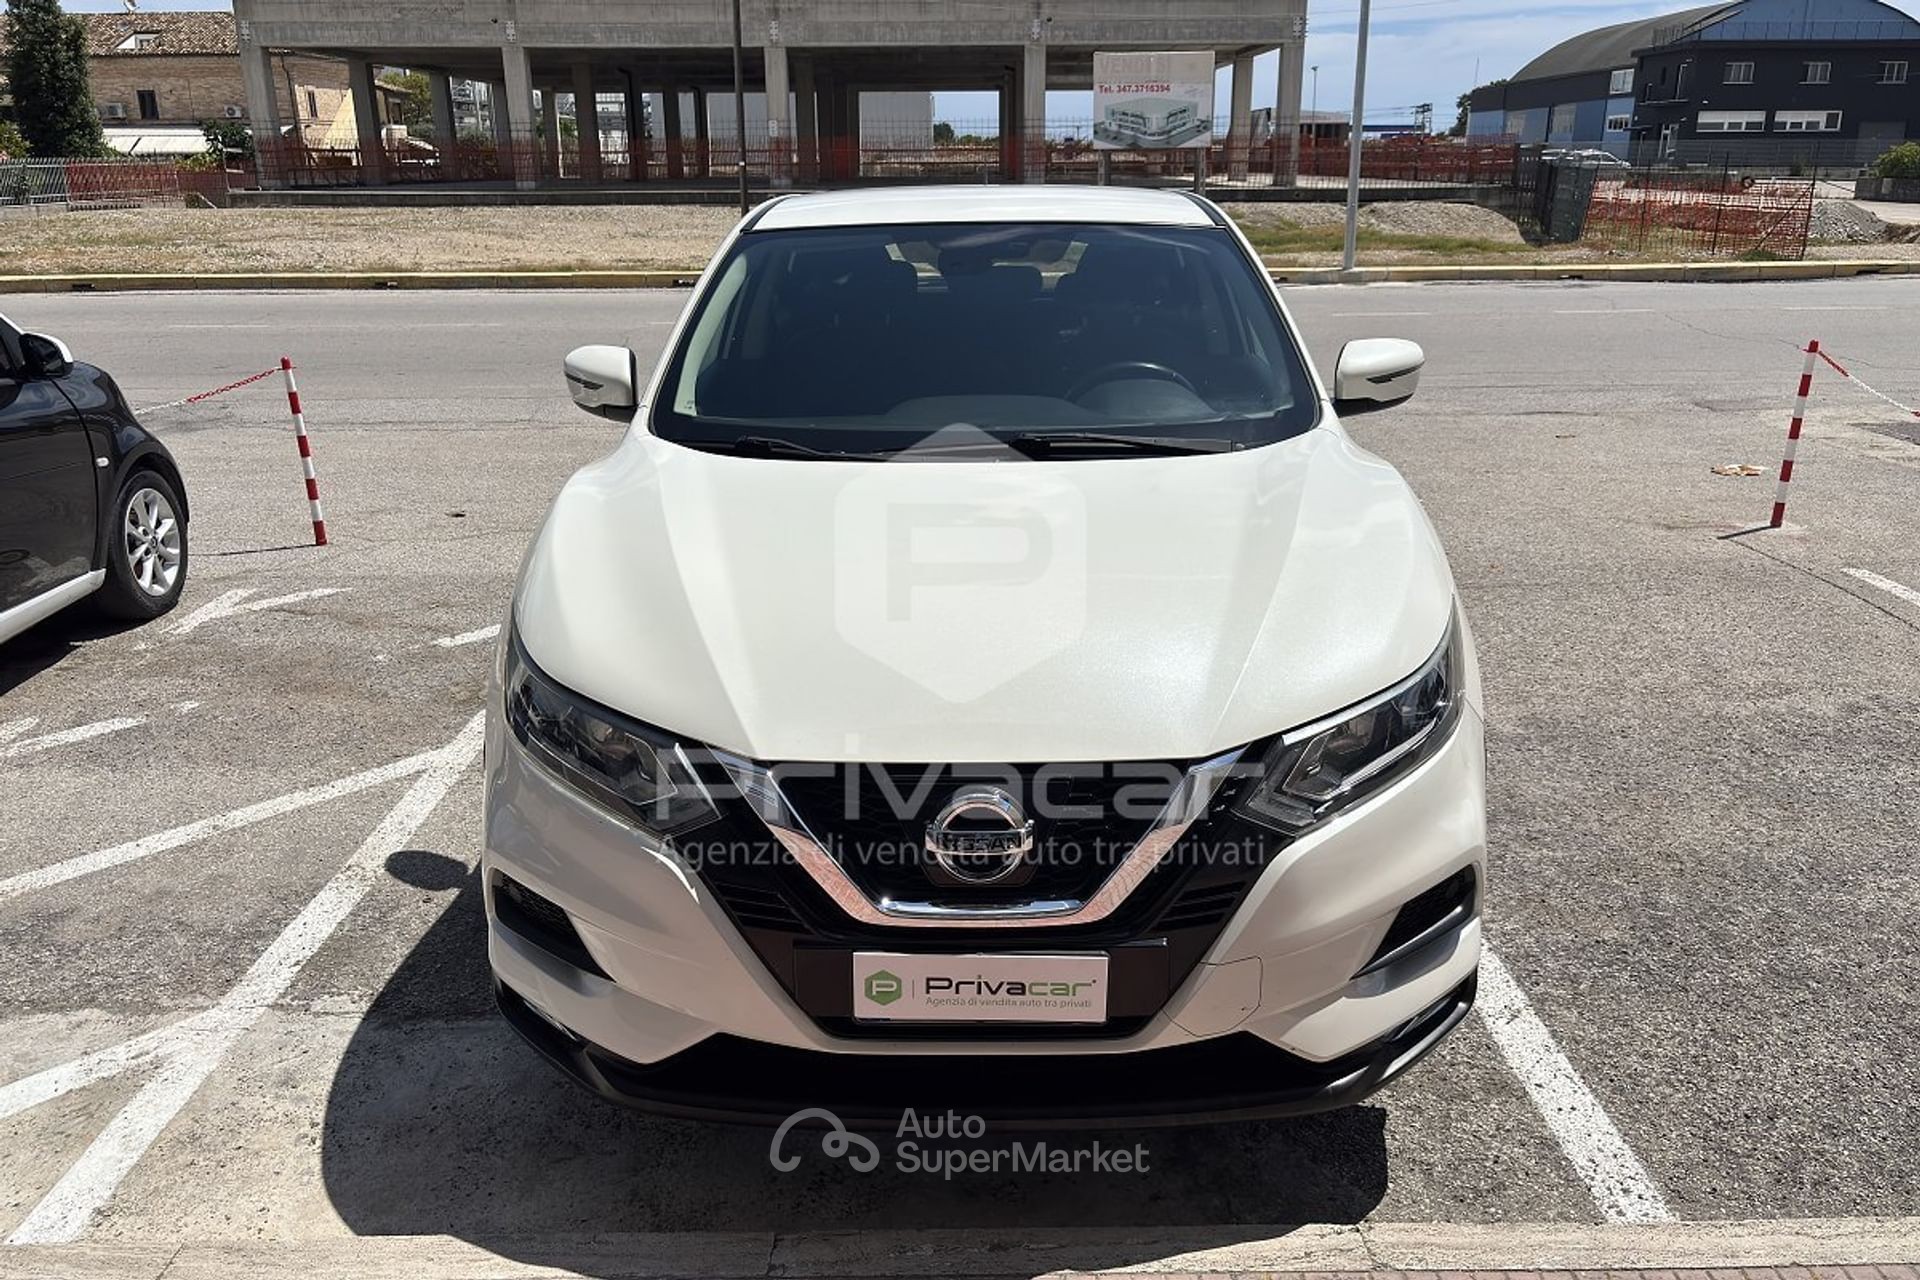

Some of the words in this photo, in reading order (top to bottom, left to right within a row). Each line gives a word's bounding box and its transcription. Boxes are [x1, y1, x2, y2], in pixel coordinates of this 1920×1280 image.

[1099, 85, 1114, 93] Tel.
[926, 997, 966, 1008] Agenzia
[968, 997, 977, 1006] di
[978, 997, 1017, 1007] vendita
[1018, 998, 1042, 1007] auto
[1044, 999, 1057, 1007] tra
[1059, 998, 1092, 1009] privati
